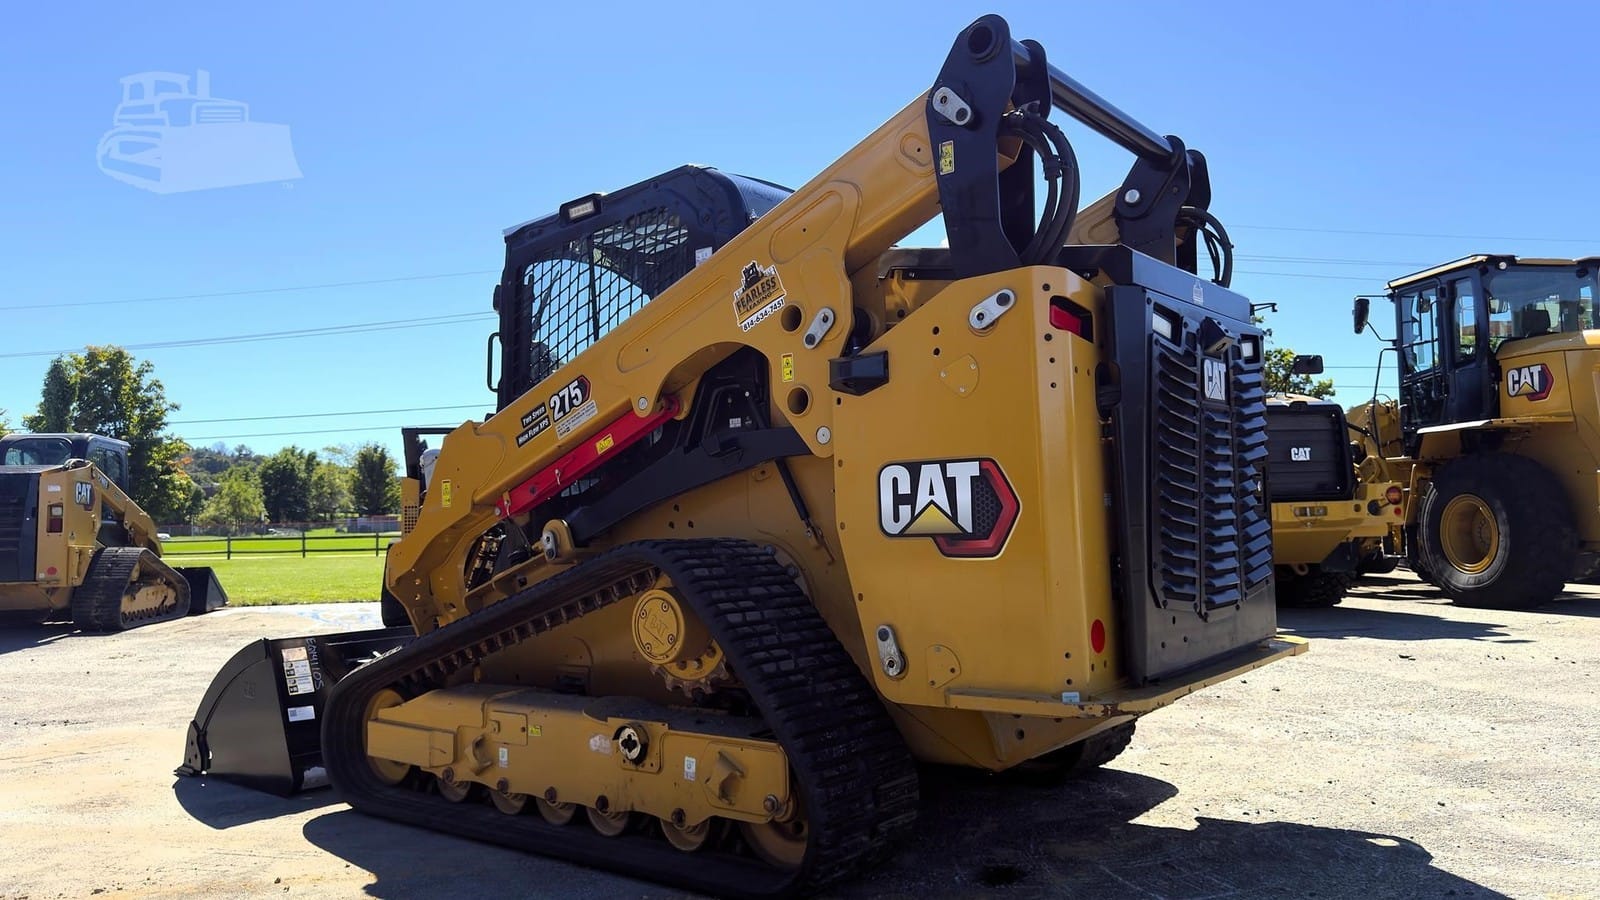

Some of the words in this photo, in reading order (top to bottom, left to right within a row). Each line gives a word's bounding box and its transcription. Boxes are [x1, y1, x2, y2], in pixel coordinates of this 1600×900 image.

[736, 276, 777, 314] FEARLESS
[746, 291, 773, 312] LEASING
[743, 298, 785, 331] 814-634-7451
[1203, 359, 1226, 401] CAT
[1507, 364, 1542, 397] CAT
[549, 379, 583, 421] 275
[1290, 447, 1311, 461] CAT
[75, 482, 92, 505] CAT
[879, 461, 980, 535] CAT
